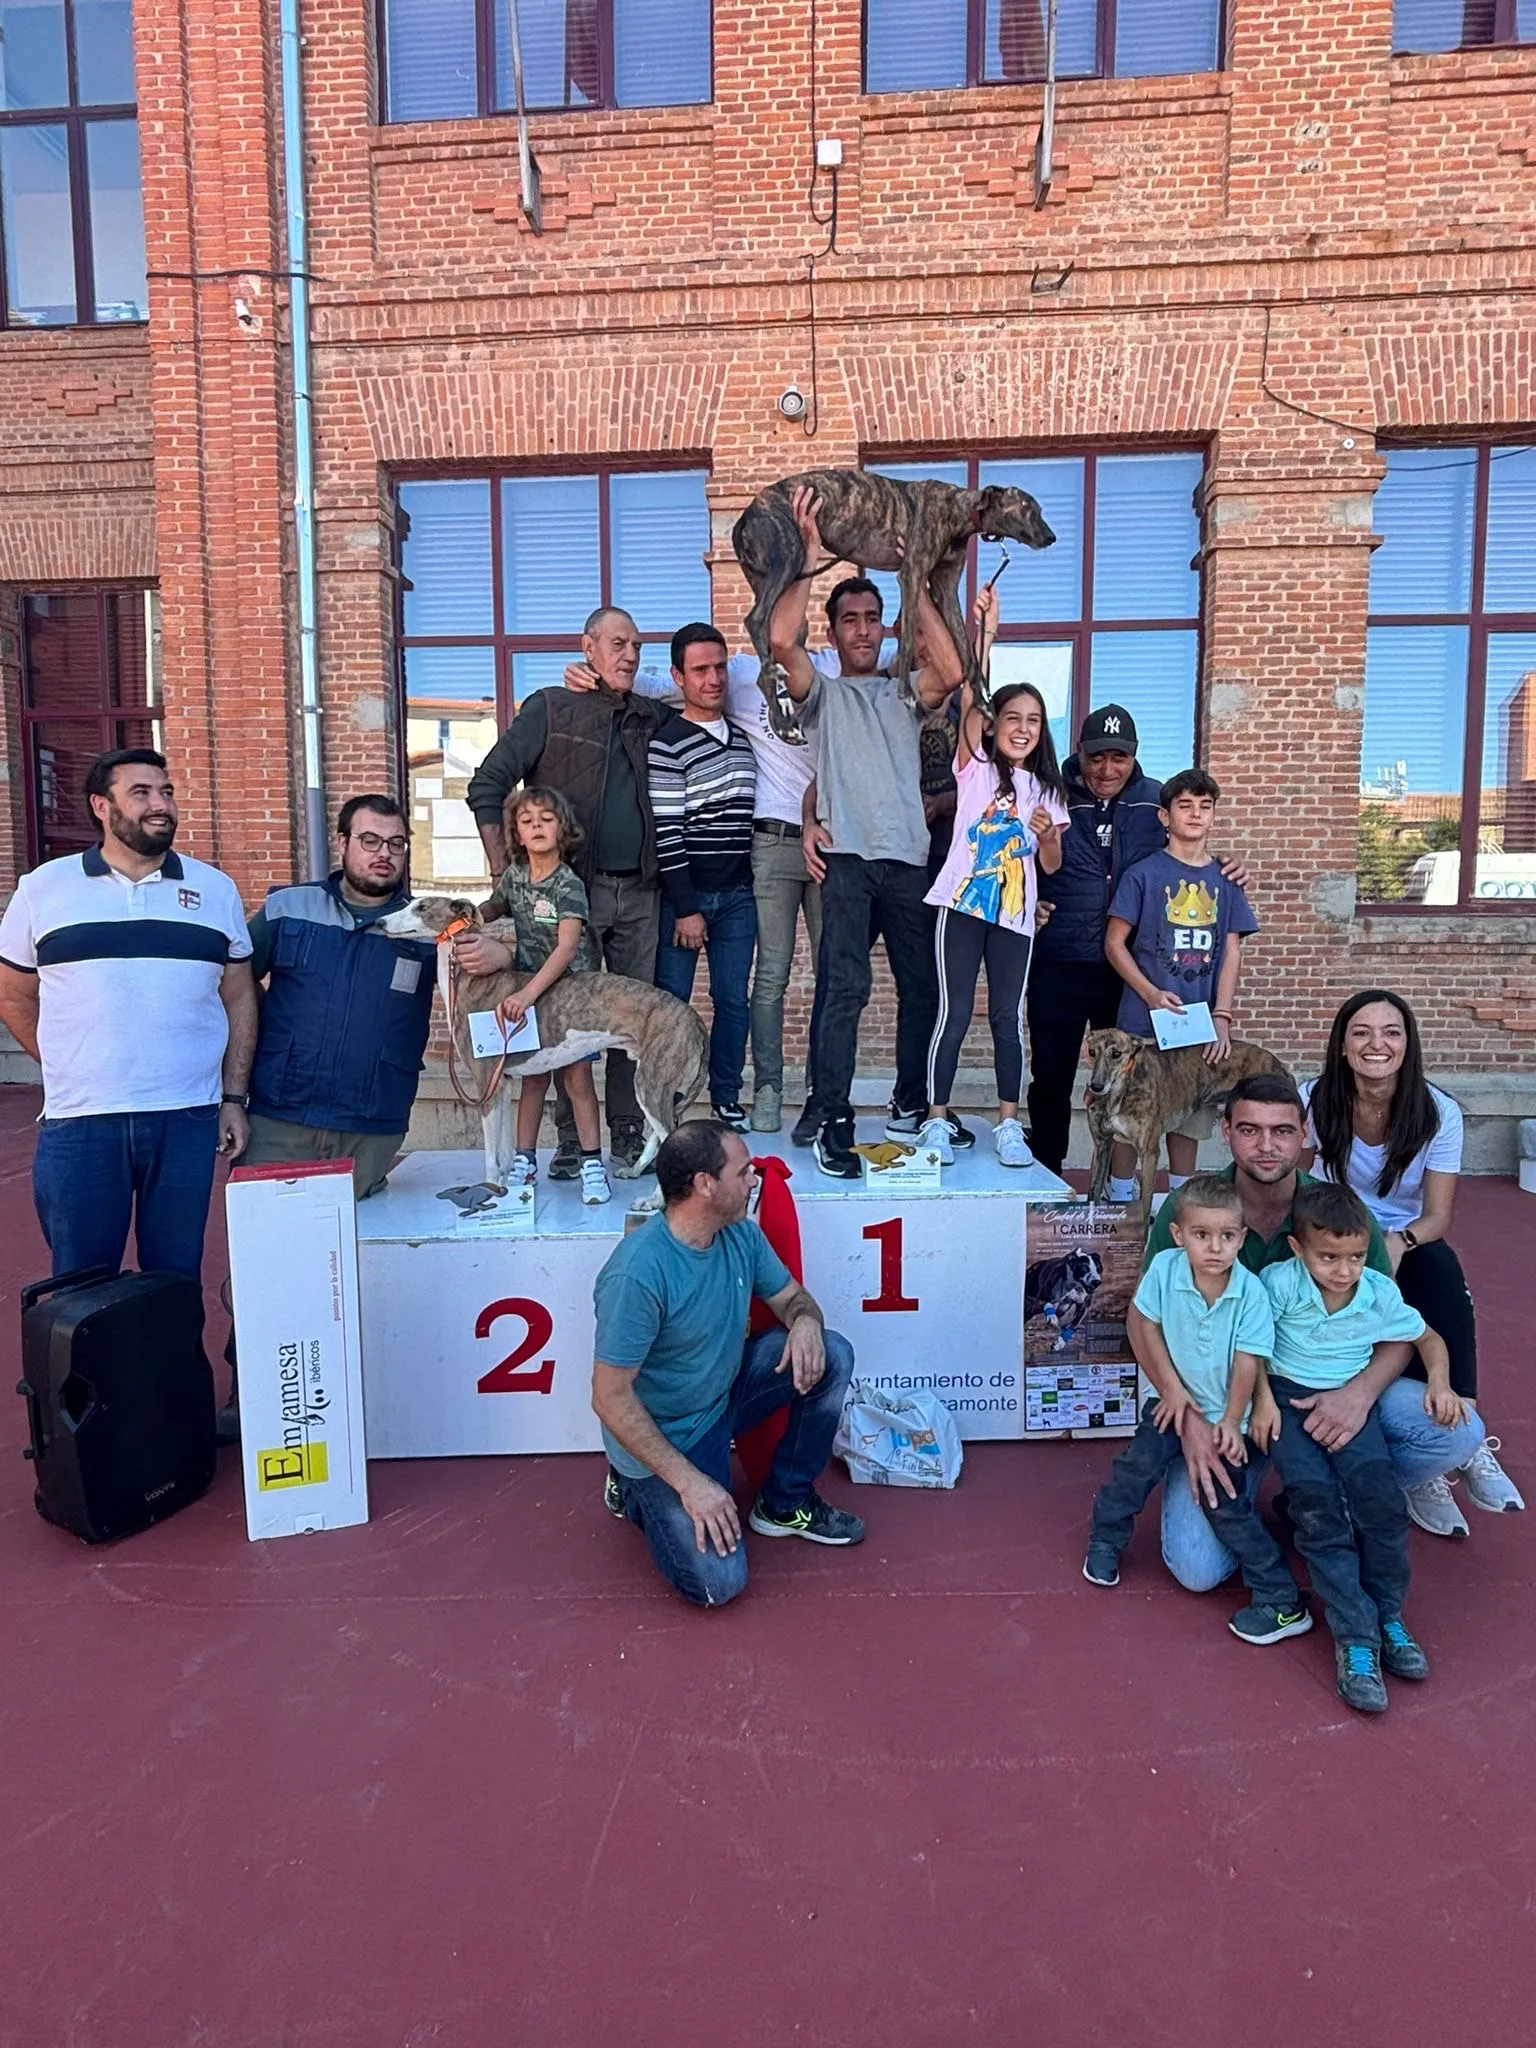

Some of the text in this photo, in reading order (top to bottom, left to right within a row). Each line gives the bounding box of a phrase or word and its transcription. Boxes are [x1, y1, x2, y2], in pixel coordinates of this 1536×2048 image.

[763, 725, 774, 739] ON
[1103, 716, 1121, 734] NY
[1174, 928, 1213, 950] ED
[1060, 1224, 1118, 1234] CARRERA
[862, 1217, 919, 1312] 1
[332, 1284, 340, 1296] por
[475, 1297, 556, 1395] 2
[310, 1340, 321, 1383] ibéricos
[989, 1371, 1016, 1387] de
